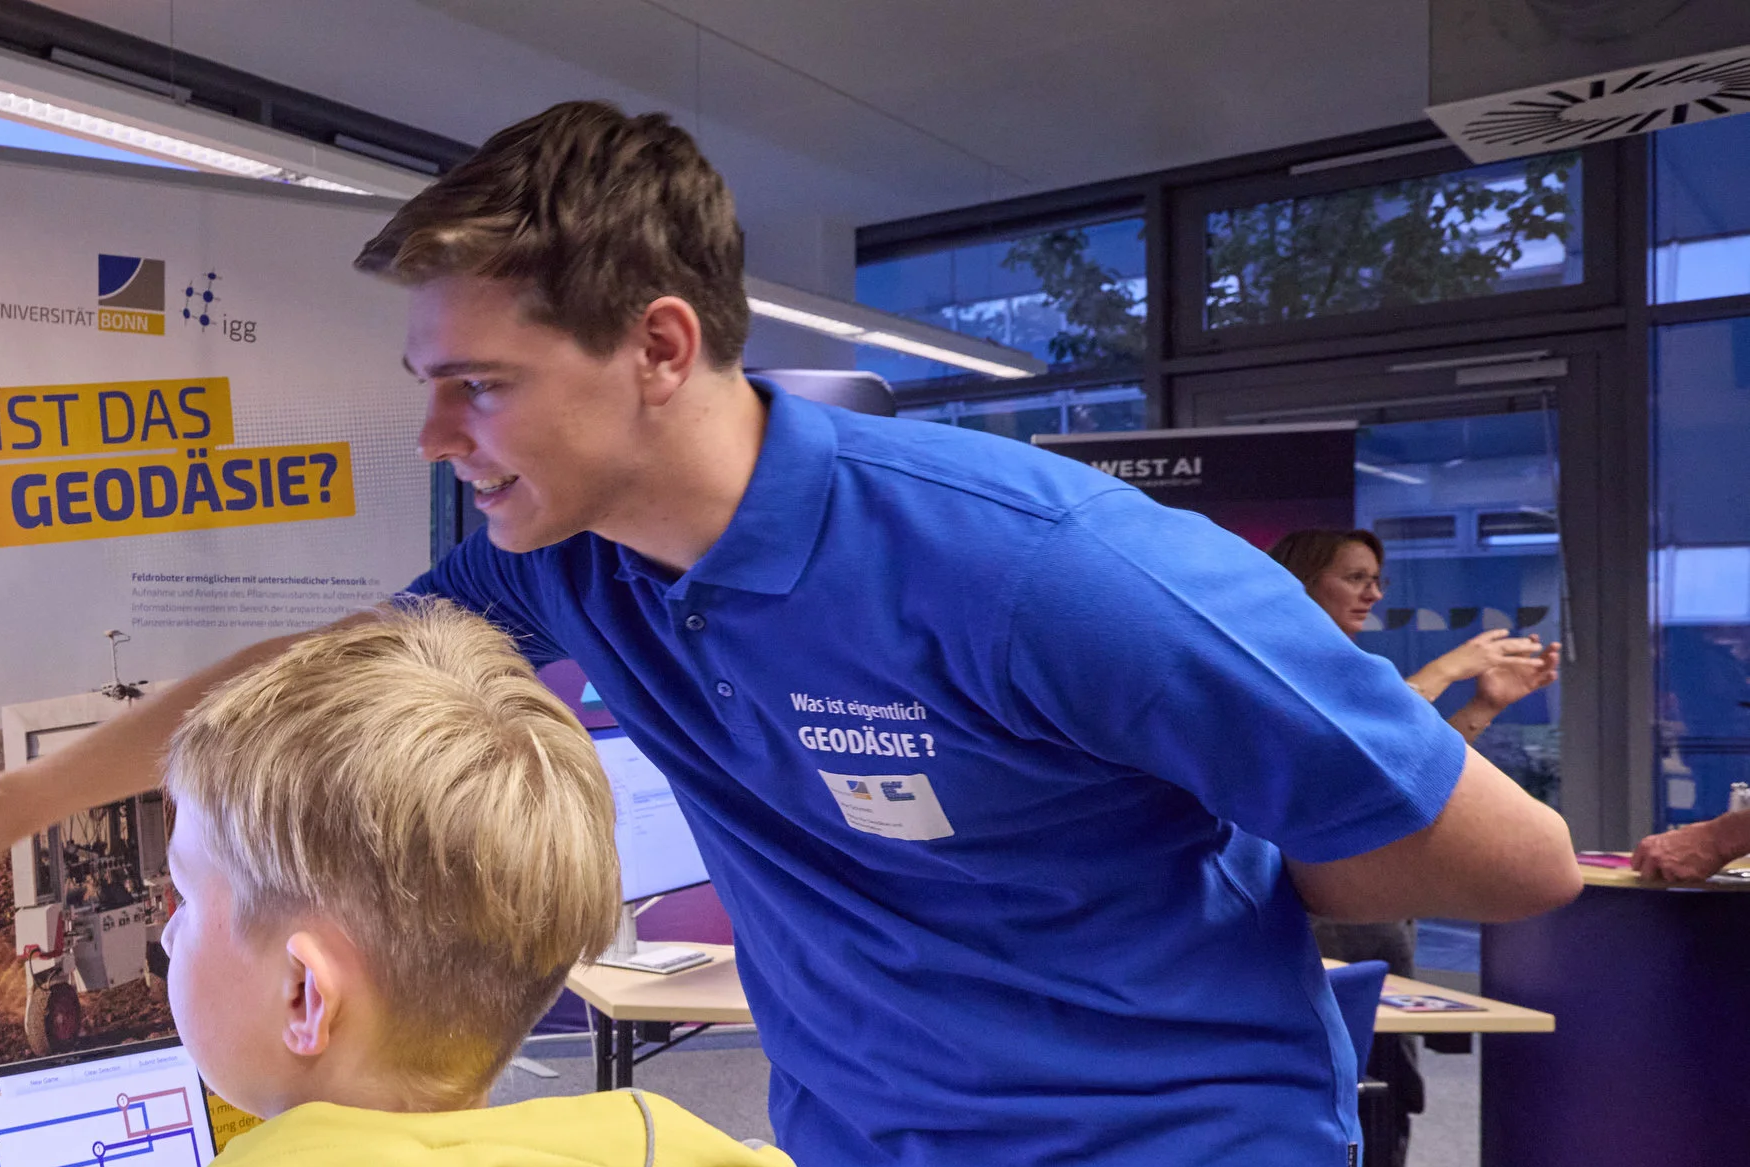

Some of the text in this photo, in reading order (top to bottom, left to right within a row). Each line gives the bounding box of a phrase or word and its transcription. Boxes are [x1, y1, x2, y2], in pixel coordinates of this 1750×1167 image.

[100, 312, 149, 332] BONN
[222, 314, 257, 343] igg
[98, 386, 211, 445] DAS
[1172, 456, 1202, 476] AI
[11, 447, 338, 530] GEODÄSIE?
[131, 573, 184, 583] Feldroboter
[186, 573, 240, 585] ermöglichen
[242, 575, 256, 584] mit
[258, 576, 329, 586] unterschiedlicher
[330, 576, 367, 586] Sensorik
[790, 693, 927, 721] Was ist eigentlich
[798, 725, 936, 758] GEODÄSIE ?
